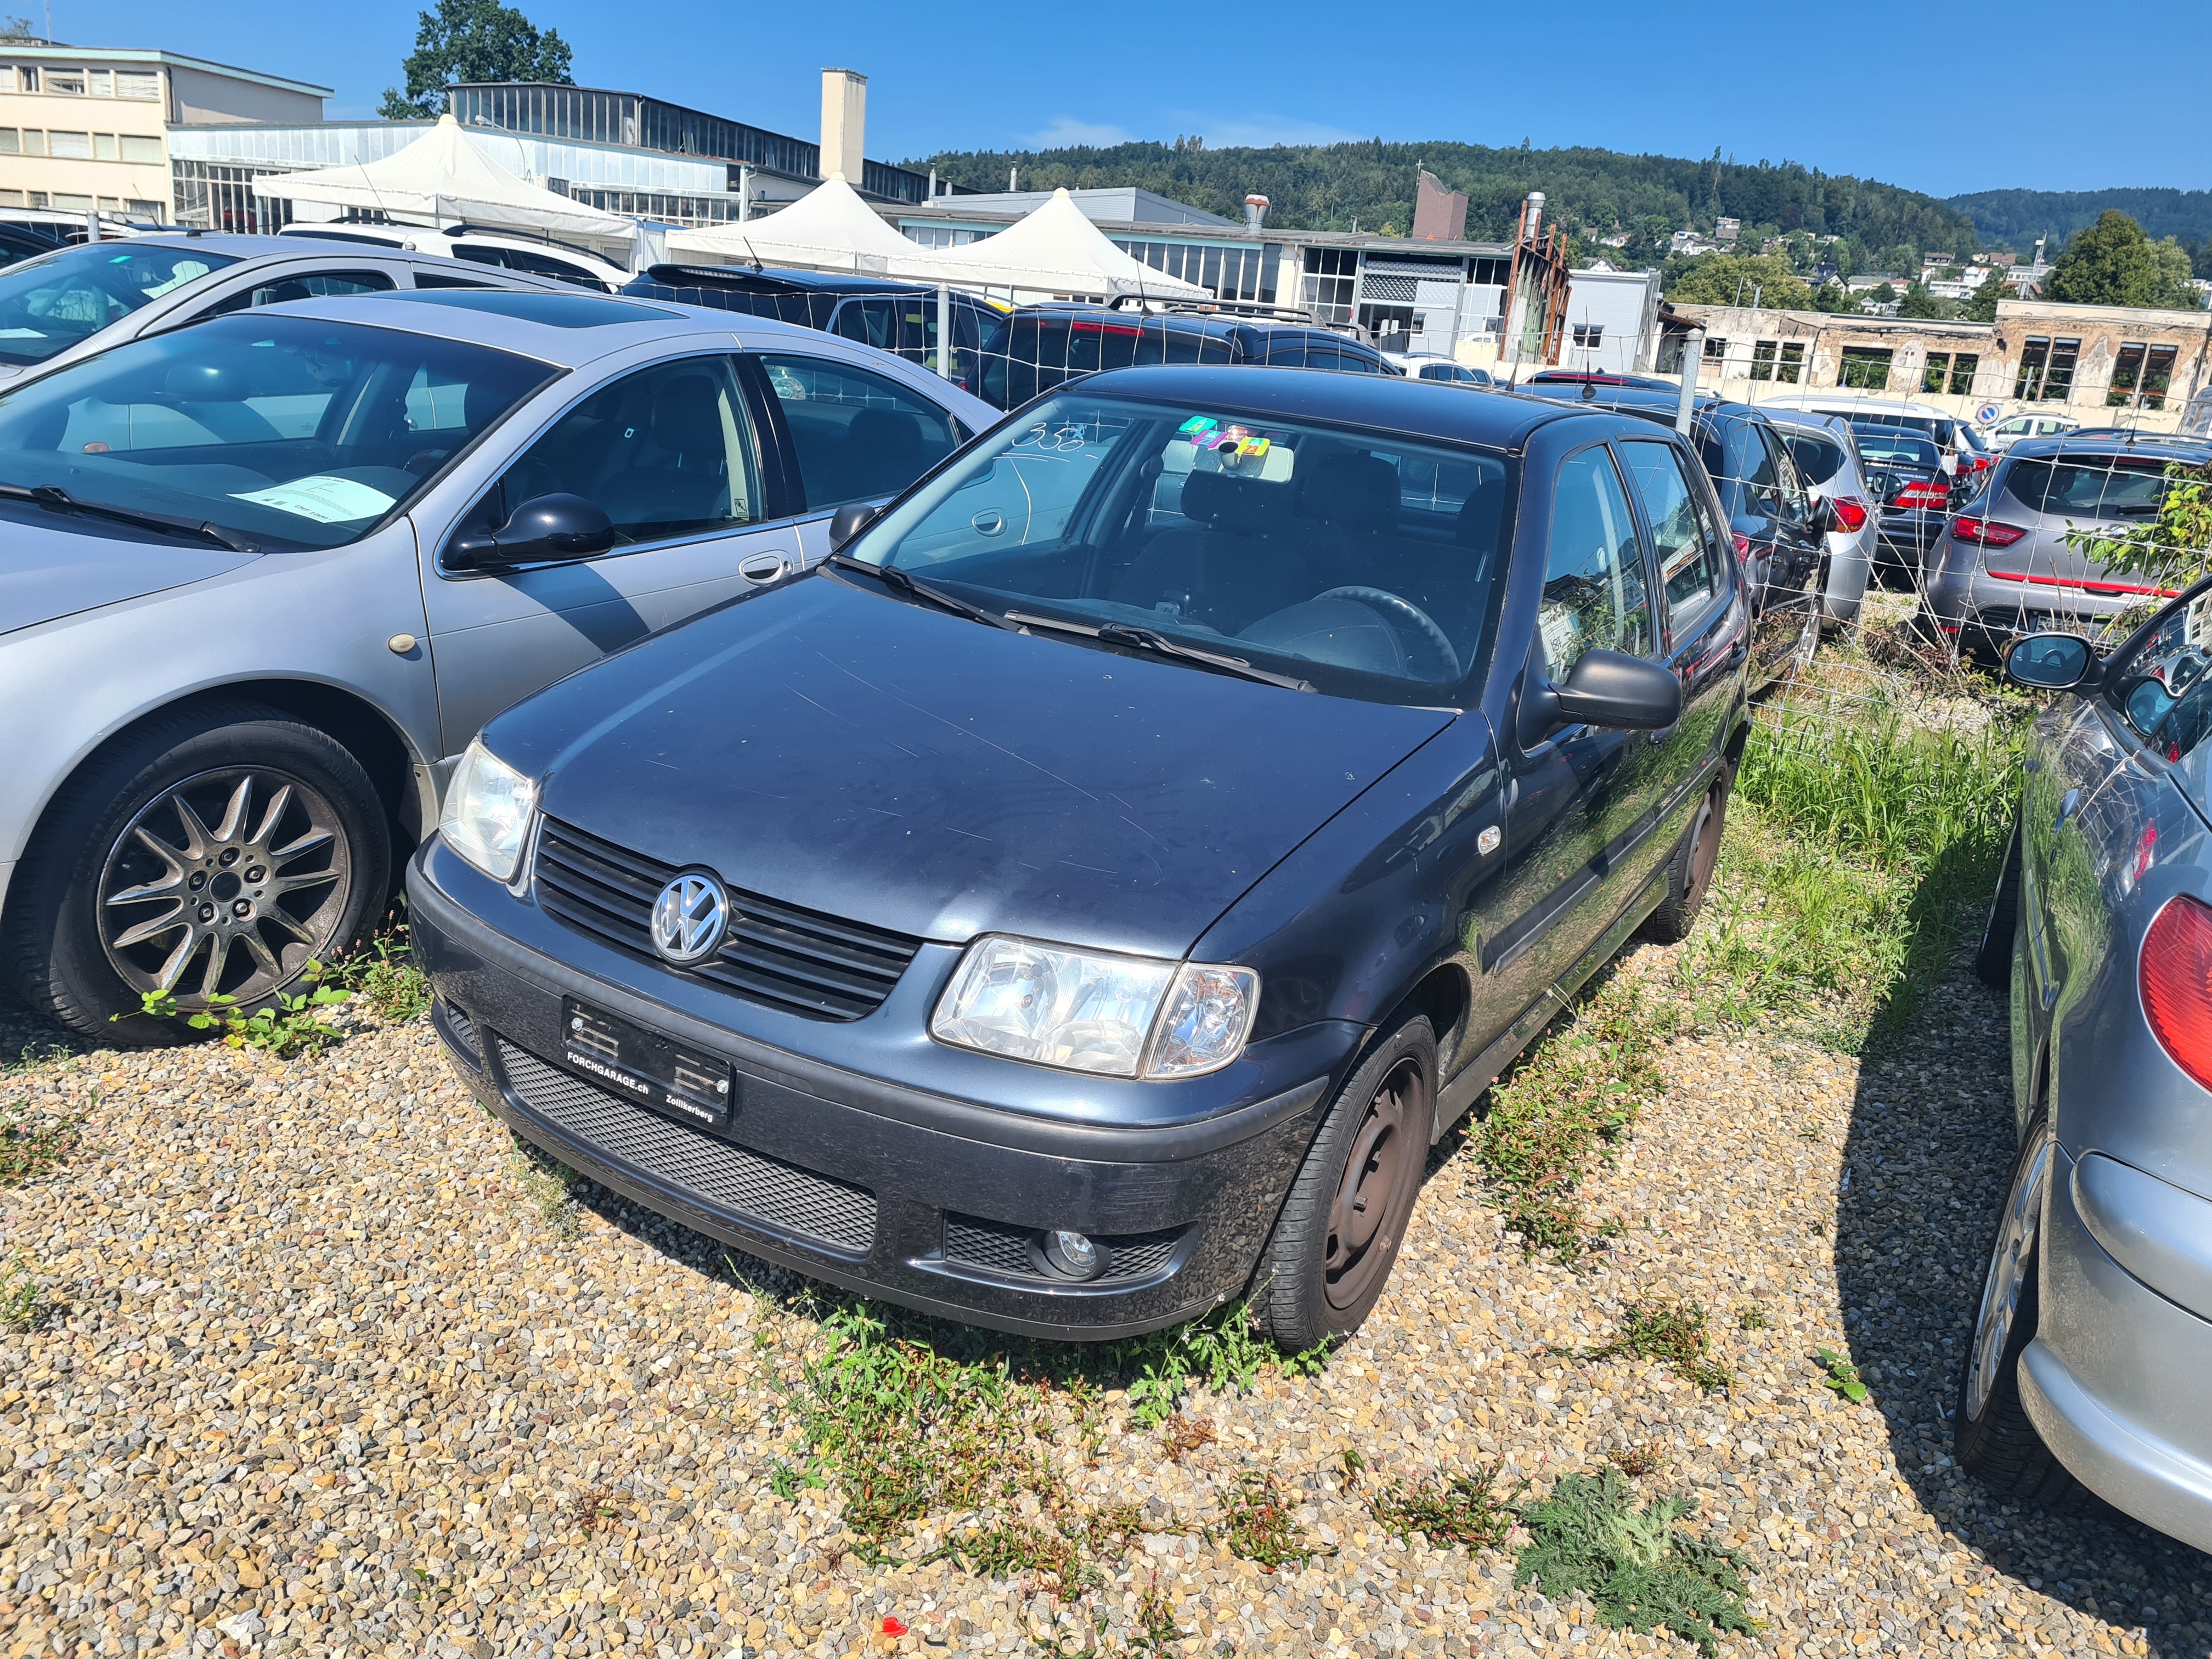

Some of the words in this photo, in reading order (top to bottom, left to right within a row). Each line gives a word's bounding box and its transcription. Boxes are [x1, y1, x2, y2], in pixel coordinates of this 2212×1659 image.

[1199, 437, 1215, 445] 22
[1244, 445, 1259, 453] 23
[567, 1051, 648, 1094] FORCHGARAGE.ch
[665, 1094, 713, 1123] Zollikerberg
